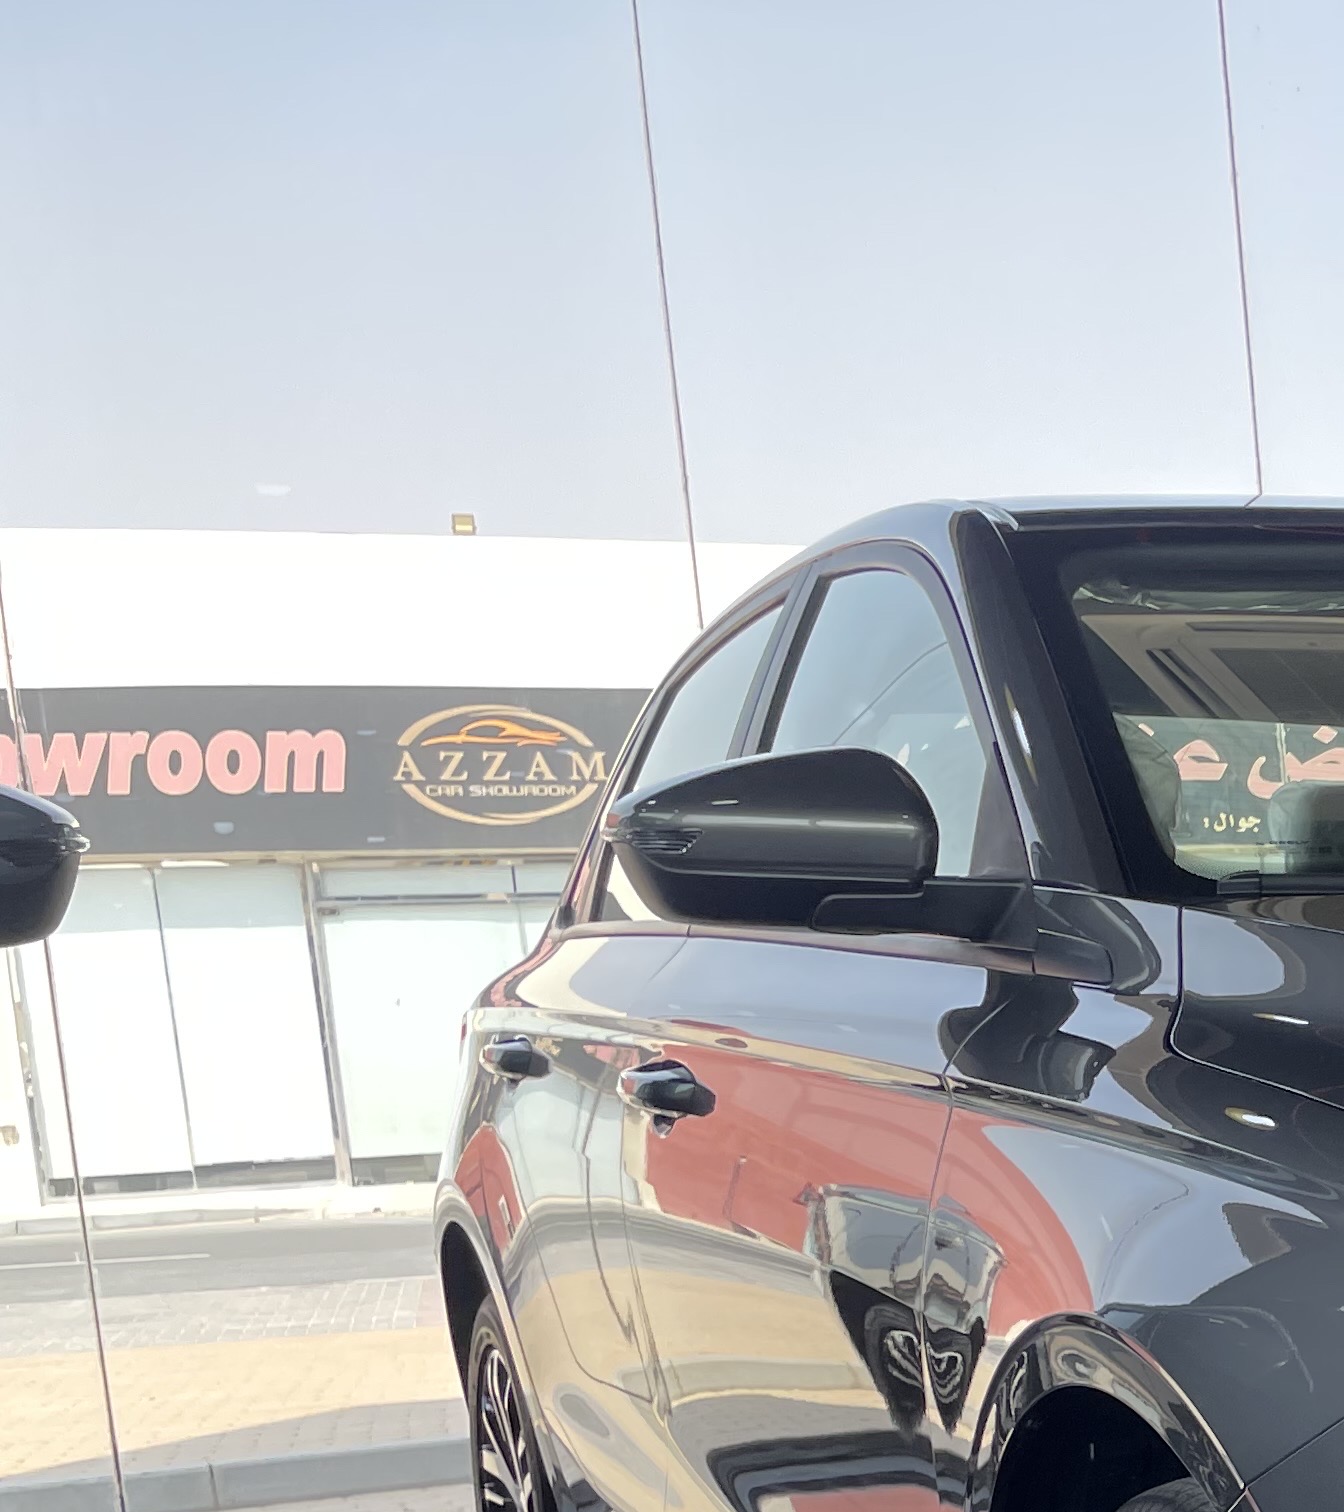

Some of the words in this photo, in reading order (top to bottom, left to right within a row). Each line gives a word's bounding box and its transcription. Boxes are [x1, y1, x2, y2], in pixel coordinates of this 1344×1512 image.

[392, 750, 610, 782] AZZAM
[425, 783, 464, 798] CAR
[468, 783, 578, 798] SHOWROOM
